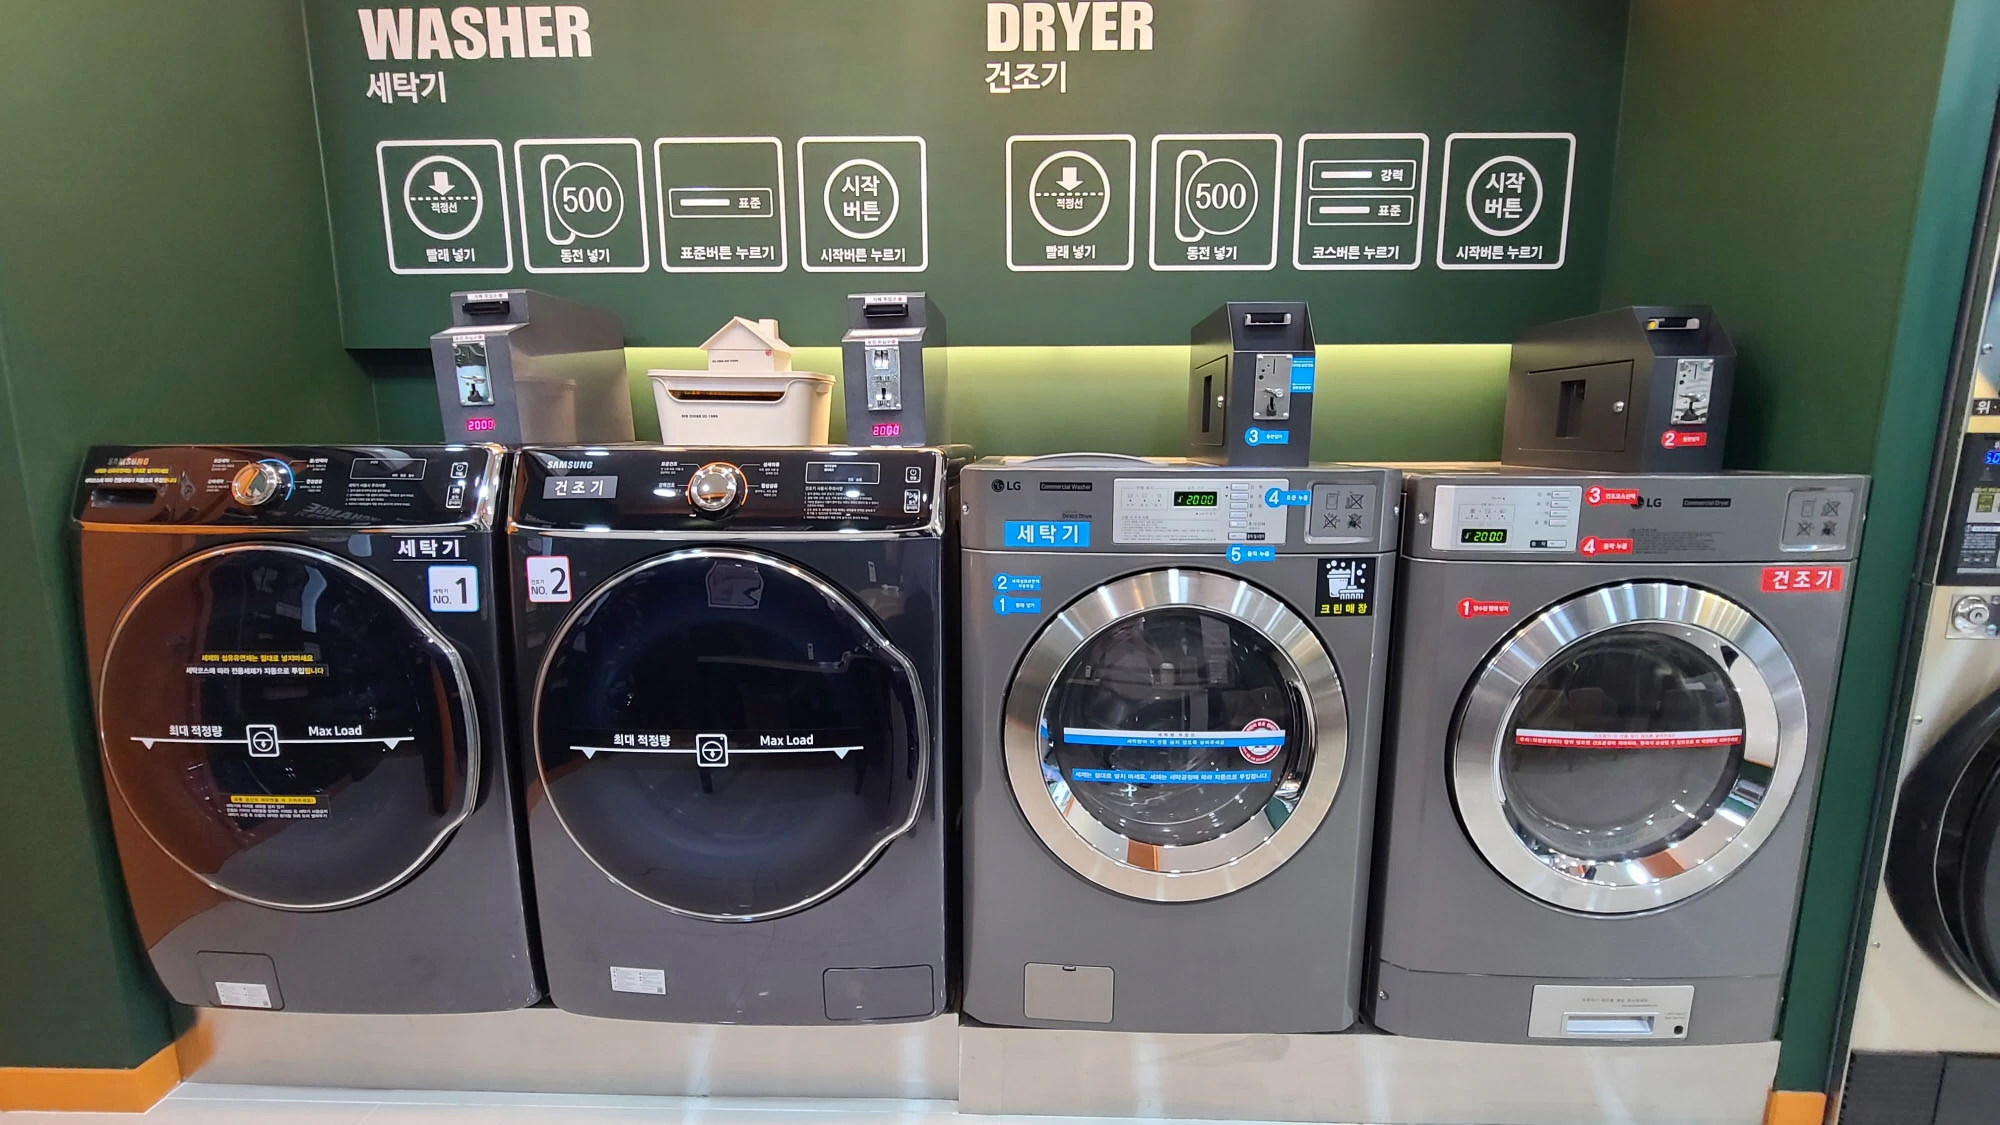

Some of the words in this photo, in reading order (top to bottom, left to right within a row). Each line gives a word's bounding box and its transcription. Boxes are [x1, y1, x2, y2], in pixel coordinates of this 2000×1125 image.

[358, 5, 592, 60] WASHER
[986, 1, 1154, 52] DRYER
[985, 61, 1067, 94] 건조기
[366, 71, 447, 103] 세탁기
[1380, 168, 1404, 182] 강력
[841, 174, 880, 197] 시작
[1486, 172, 1525, 195] 시작
[562, 186, 613, 214] 500
[738, 196, 761, 210] 표준
[1056, 197, 1083, 210] 적정선
[1195, 182, 1247, 210] 500
[431, 201, 458, 214] 적정선
[842, 201, 881, 223] 버튼
[1378, 204, 1401, 217] 표준
[1484, 197, 1522, 219] 버튼
[426, 247, 450, 263] 빨래
[453, 247, 476, 262] 넣기
[560, 248, 583, 263] 동전
[586, 248, 610, 263] 넣기
[680, 246, 732, 262] 표준버튼
[736, 245, 775, 261] 누르기
[821, 248, 867, 263] 시작버튼
[870, 248, 906, 263] 누르기
[1046, 244, 1069, 260] 빨래
[1073, 244, 1096, 259] 넣기
[1187, 245, 1210, 261] 동전
[1214, 245, 1237, 260] 넣기
[1312, 244, 1360, 260] 코스버튼
[1363, 244, 1399, 260] 누르기
[1456, 245, 1502, 261] 시작버튼
[1506, 245, 1543, 260] 누르기
[468, 420, 494, 430] 2000
[872, 424, 899, 436] 2000
[1249, 430, 1258, 442] 3
[1665, 432, 1675, 446] 2
[547, 461, 593, 469] SAMSUNG
[554, 481, 604, 497] 건조기
[1007, 481, 1021, 491] LG
[1186, 495, 1214, 505] 2000
[1268, 490, 1280, 504] 4
[1589, 488, 1601, 503] 3
[1646, 499, 1662, 507] LG
[1017, 525, 1078, 543] 세탁기
[1474, 531, 1504, 542] 2000
[398, 539, 460, 557] 세탁기
[1231, 547, 1241, 561] 5
[1584, 539, 1596, 554] 4
[531, 586, 548, 596] NO.
[551, 568, 568, 594] 2
[997, 576, 1008, 590] 2
[1773, 570, 1833, 590] 건조기
[433, 595, 452, 605] NO.
[455, 578, 468, 604] 1
[999, 598, 1005, 612] 1
[1320, 603, 1368, 614] 크린매장
[1463, 601, 1470, 616] 1
[169, 725, 189, 737] 최대
[191, 725, 222, 737] 적정량
[308, 725, 332, 737] Max
[334, 724, 362, 737] Load
[613, 734, 635, 746] 최대
[637, 733, 671, 747] 적정량
[760, 735, 784, 746] Max
[786, 734, 814, 746] Load
